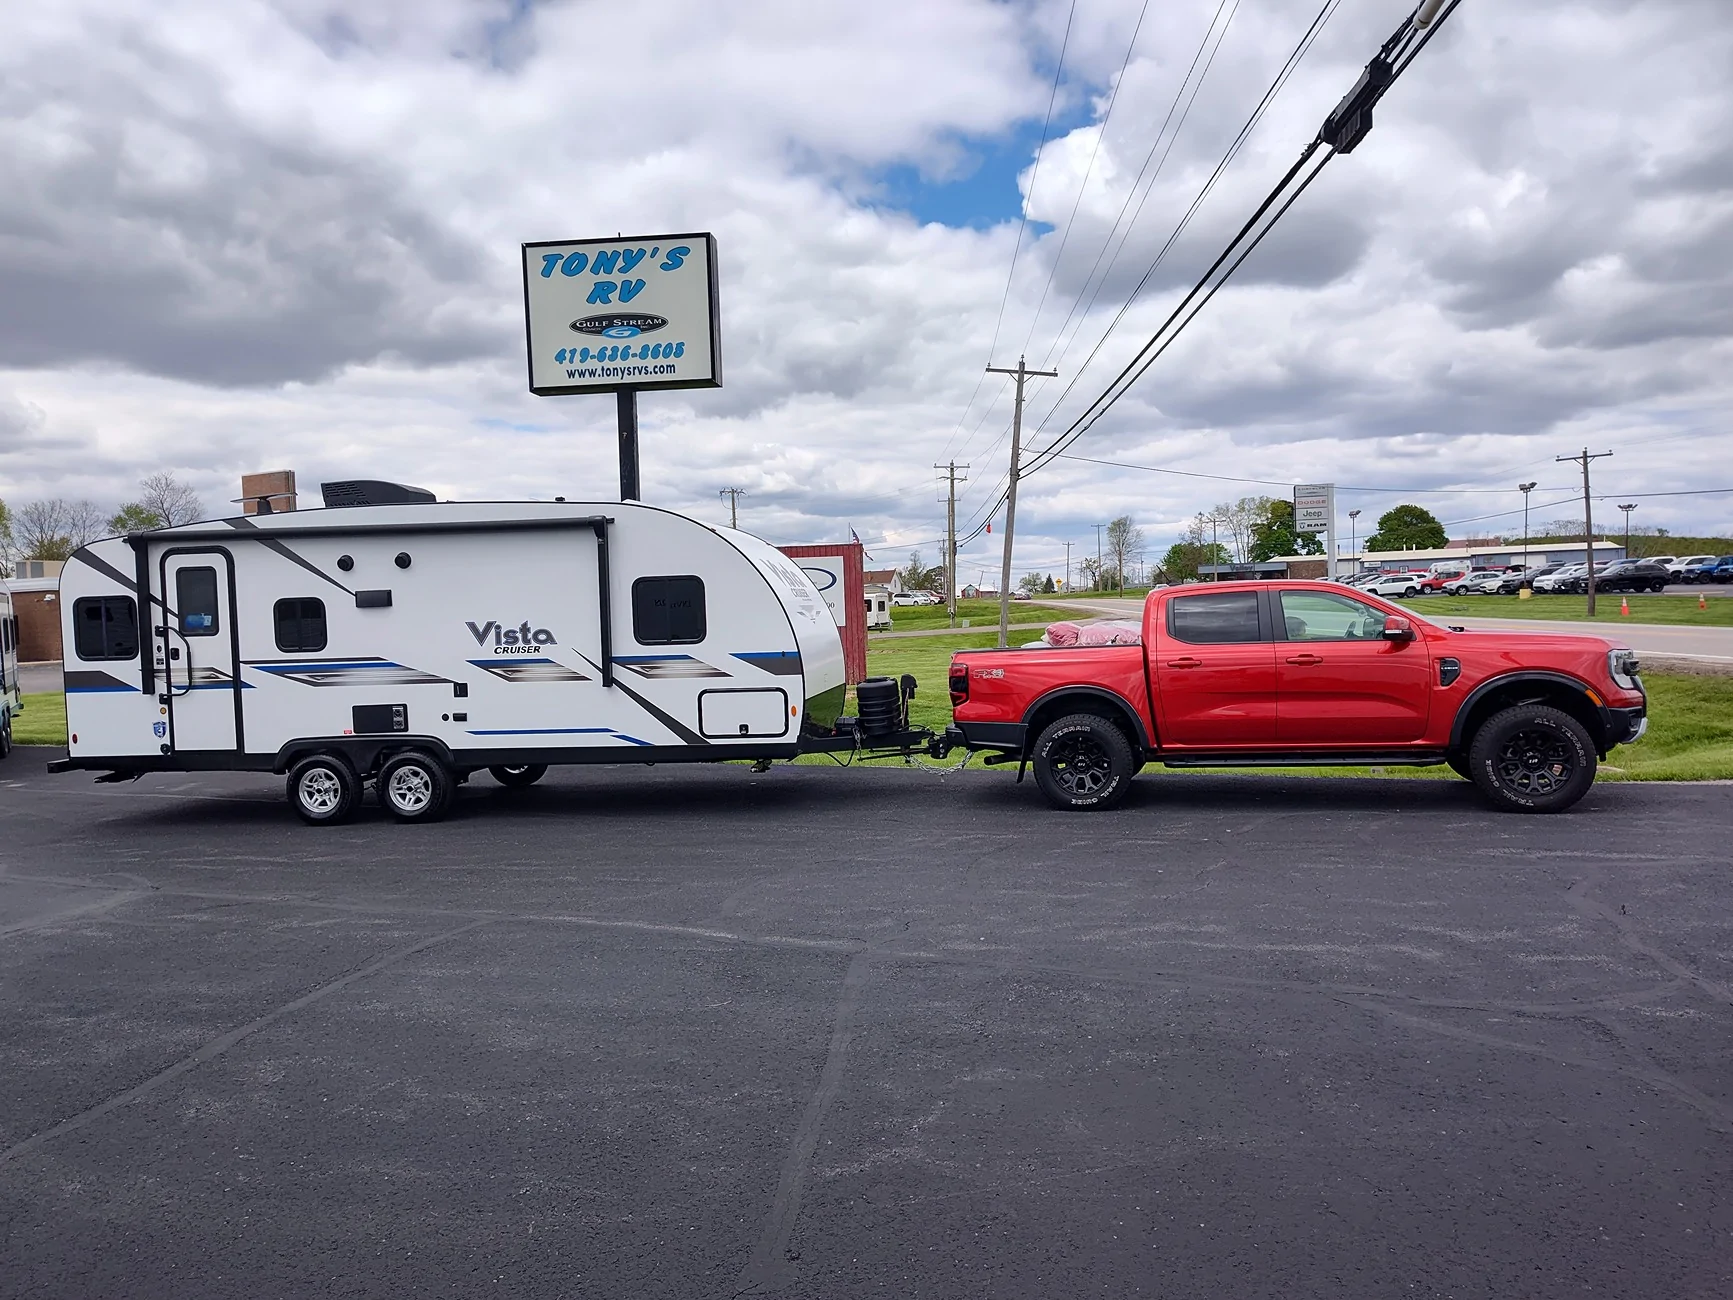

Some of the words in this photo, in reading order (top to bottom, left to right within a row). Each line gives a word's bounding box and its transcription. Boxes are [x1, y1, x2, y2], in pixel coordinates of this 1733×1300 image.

[540, 246, 691, 278] TONY'S
[586, 278, 646, 304] RV
[576, 320, 609, 328] GULF
[554, 341, 685, 365] 419-636-8605
[566, 363, 676, 380] www.tonysrvs.com
[464, 620, 558, 647] Vista
[494, 646, 541, 655] CRUISER
[1534, 717, 1556, 727] ALL
[1041, 741, 1053, 758] ALL
[1052, 725, 1091, 739] TERRAIN
[1100, 775, 1120, 797] TRAIL
